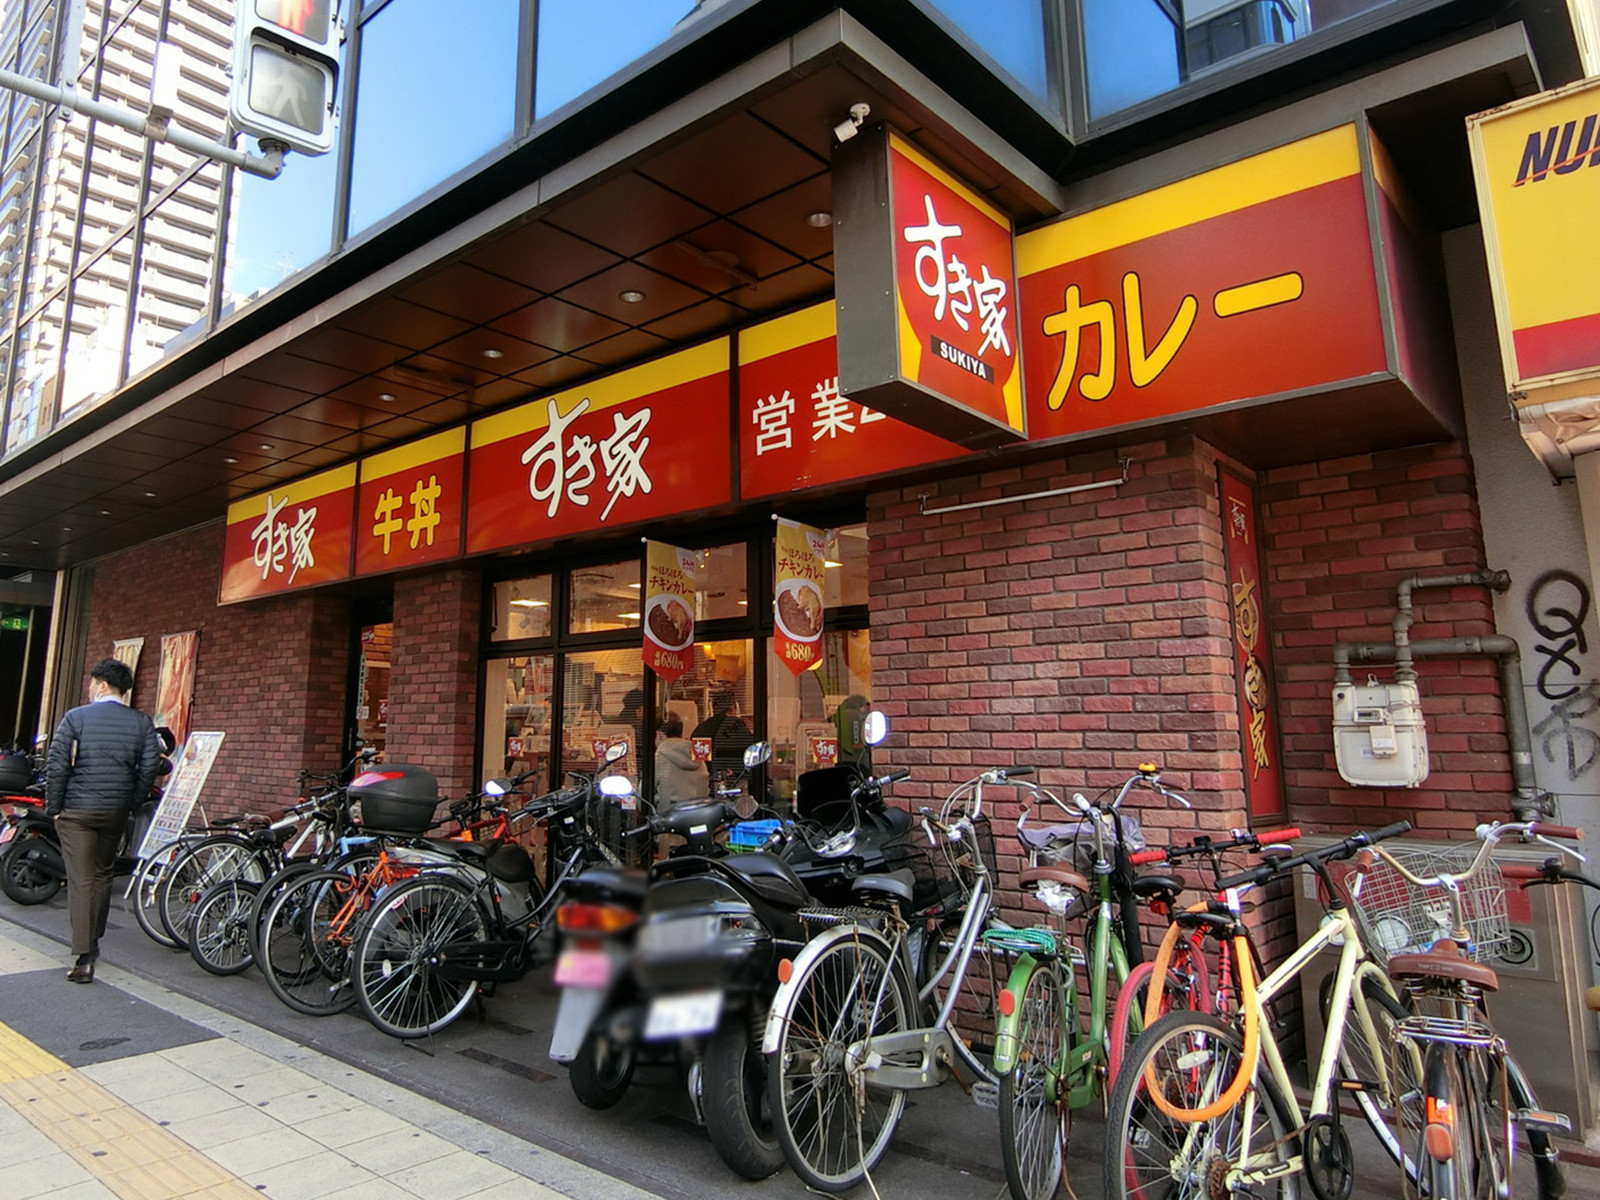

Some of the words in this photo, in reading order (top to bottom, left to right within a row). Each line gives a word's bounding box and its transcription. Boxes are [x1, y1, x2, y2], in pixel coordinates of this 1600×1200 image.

[903, 194, 1011, 357] すき家
[939, 341, 987, 380] SUKIYA
[1043, 271, 1304, 412] カレー
[521, 398, 653, 522] すき家
[251, 493, 318, 585] すき家
[372, 474, 442, 556] 牛丼
[649, 575, 694, 595] チキンカレー
[777, 557, 825, 580] チキンカレー
